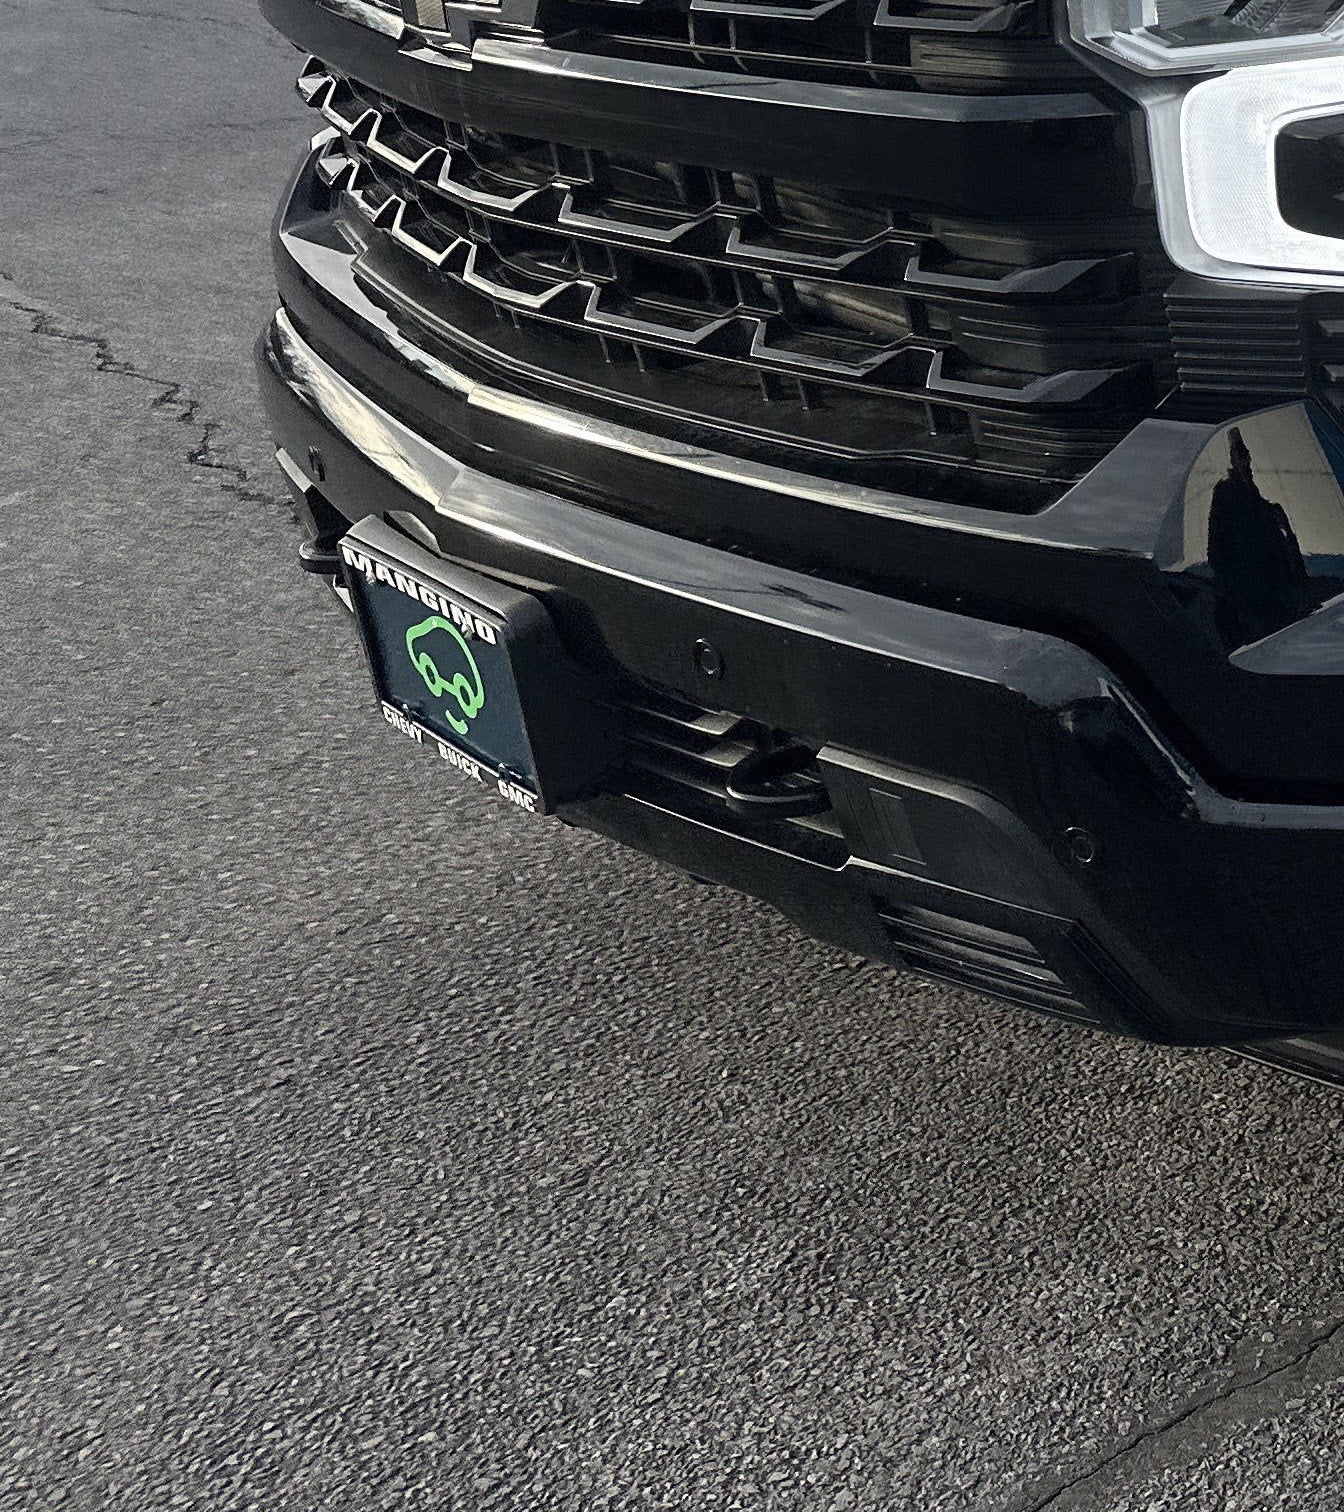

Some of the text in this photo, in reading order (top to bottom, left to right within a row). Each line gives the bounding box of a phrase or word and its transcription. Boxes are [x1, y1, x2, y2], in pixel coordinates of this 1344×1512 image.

[341, 545, 497, 645] MANGINO
[384, 707, 536, 812] CHEVY BUICK GMC
